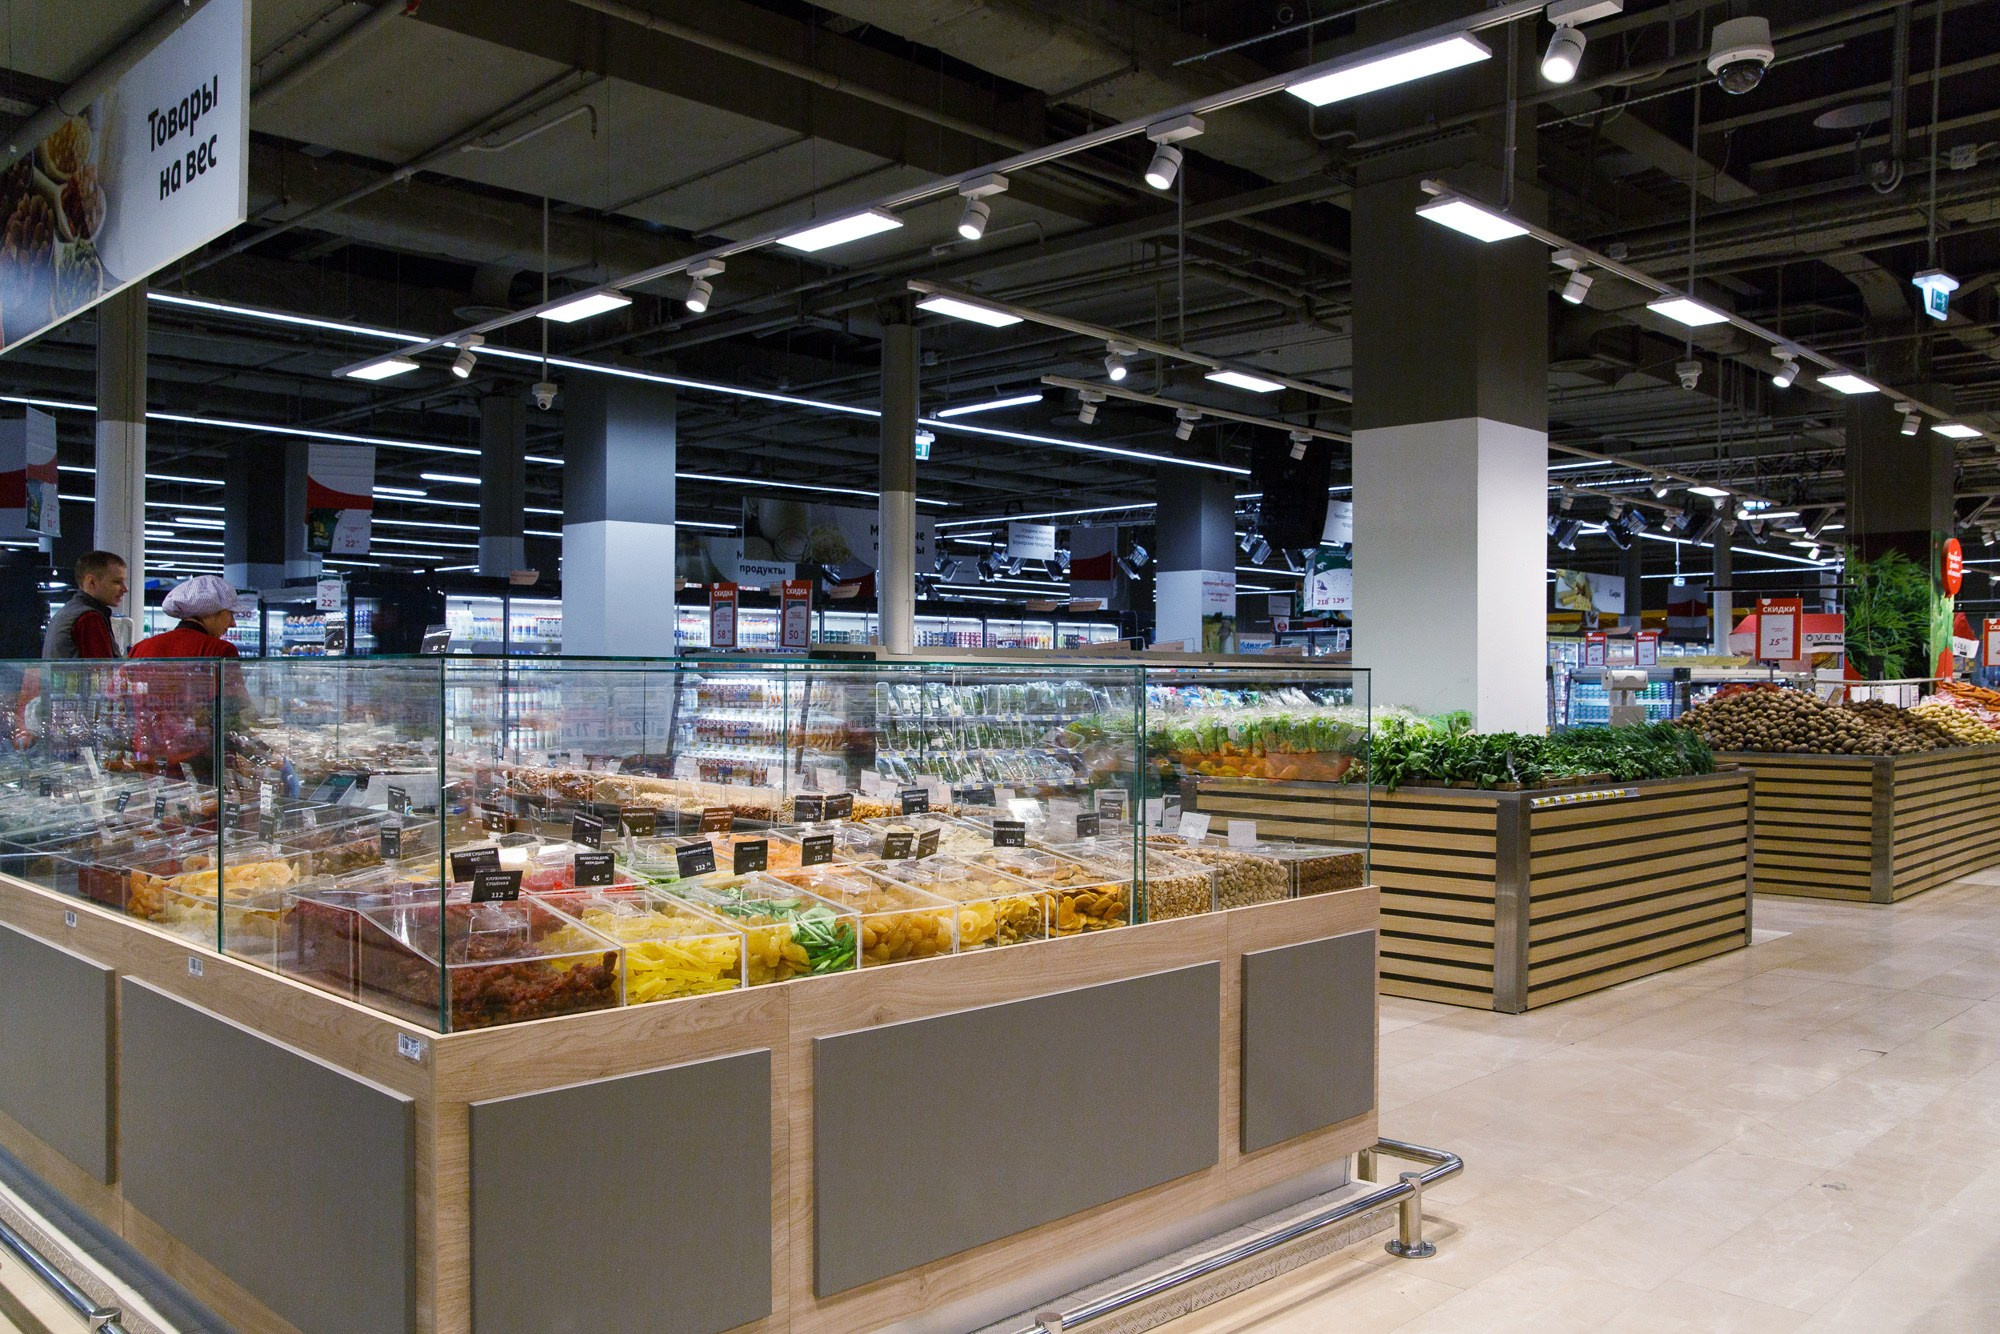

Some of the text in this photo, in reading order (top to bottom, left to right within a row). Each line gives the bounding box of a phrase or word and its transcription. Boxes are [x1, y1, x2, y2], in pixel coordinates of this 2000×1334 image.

[148, 74, 218, 153] Товары
[160, 133, 217, 201] на вес
[739, 564, 786, 576] продукты
[786, 588, 808, 596] СКИДКА
[321, 599, 333, 607] 22
[1762, 606, 1796, 614] СКИДКИ
[718, 630, 726, 639] 58
[789, 630, 799, 639] 50
[1769, 638, 1780, 646] 15
